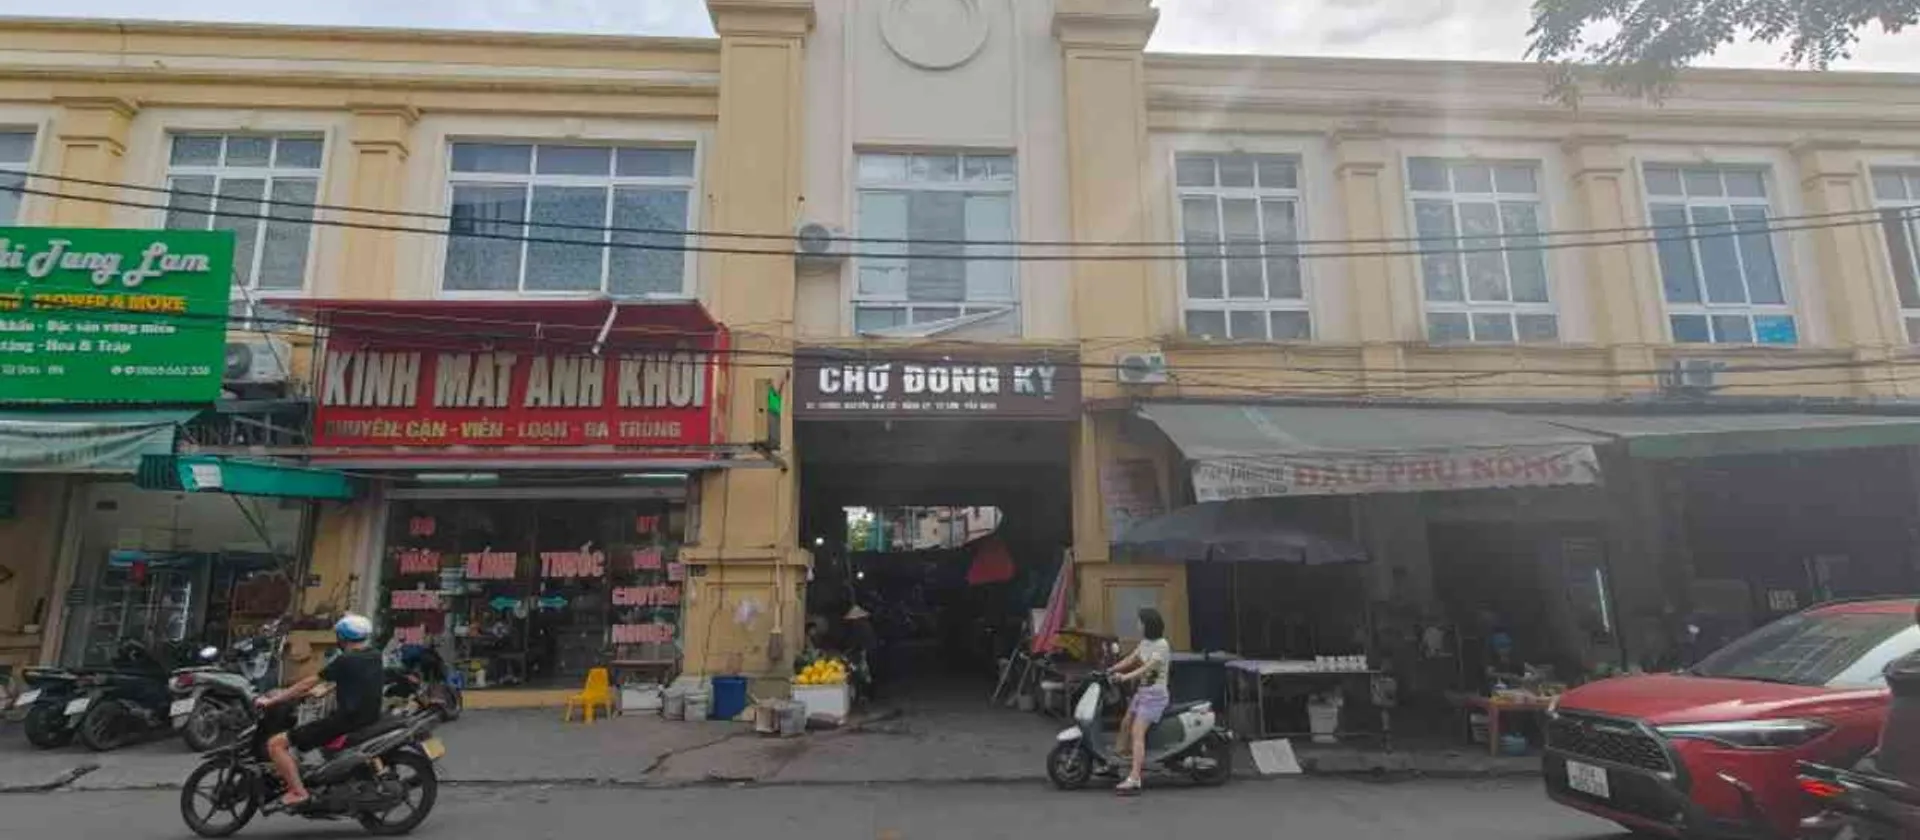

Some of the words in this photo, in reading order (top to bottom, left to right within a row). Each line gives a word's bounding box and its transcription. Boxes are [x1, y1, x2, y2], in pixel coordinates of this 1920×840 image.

[123, 241, 211, 287] Lam
[127, 294, 188, 312] MORE
[523, 353, 605, 407] ANH
